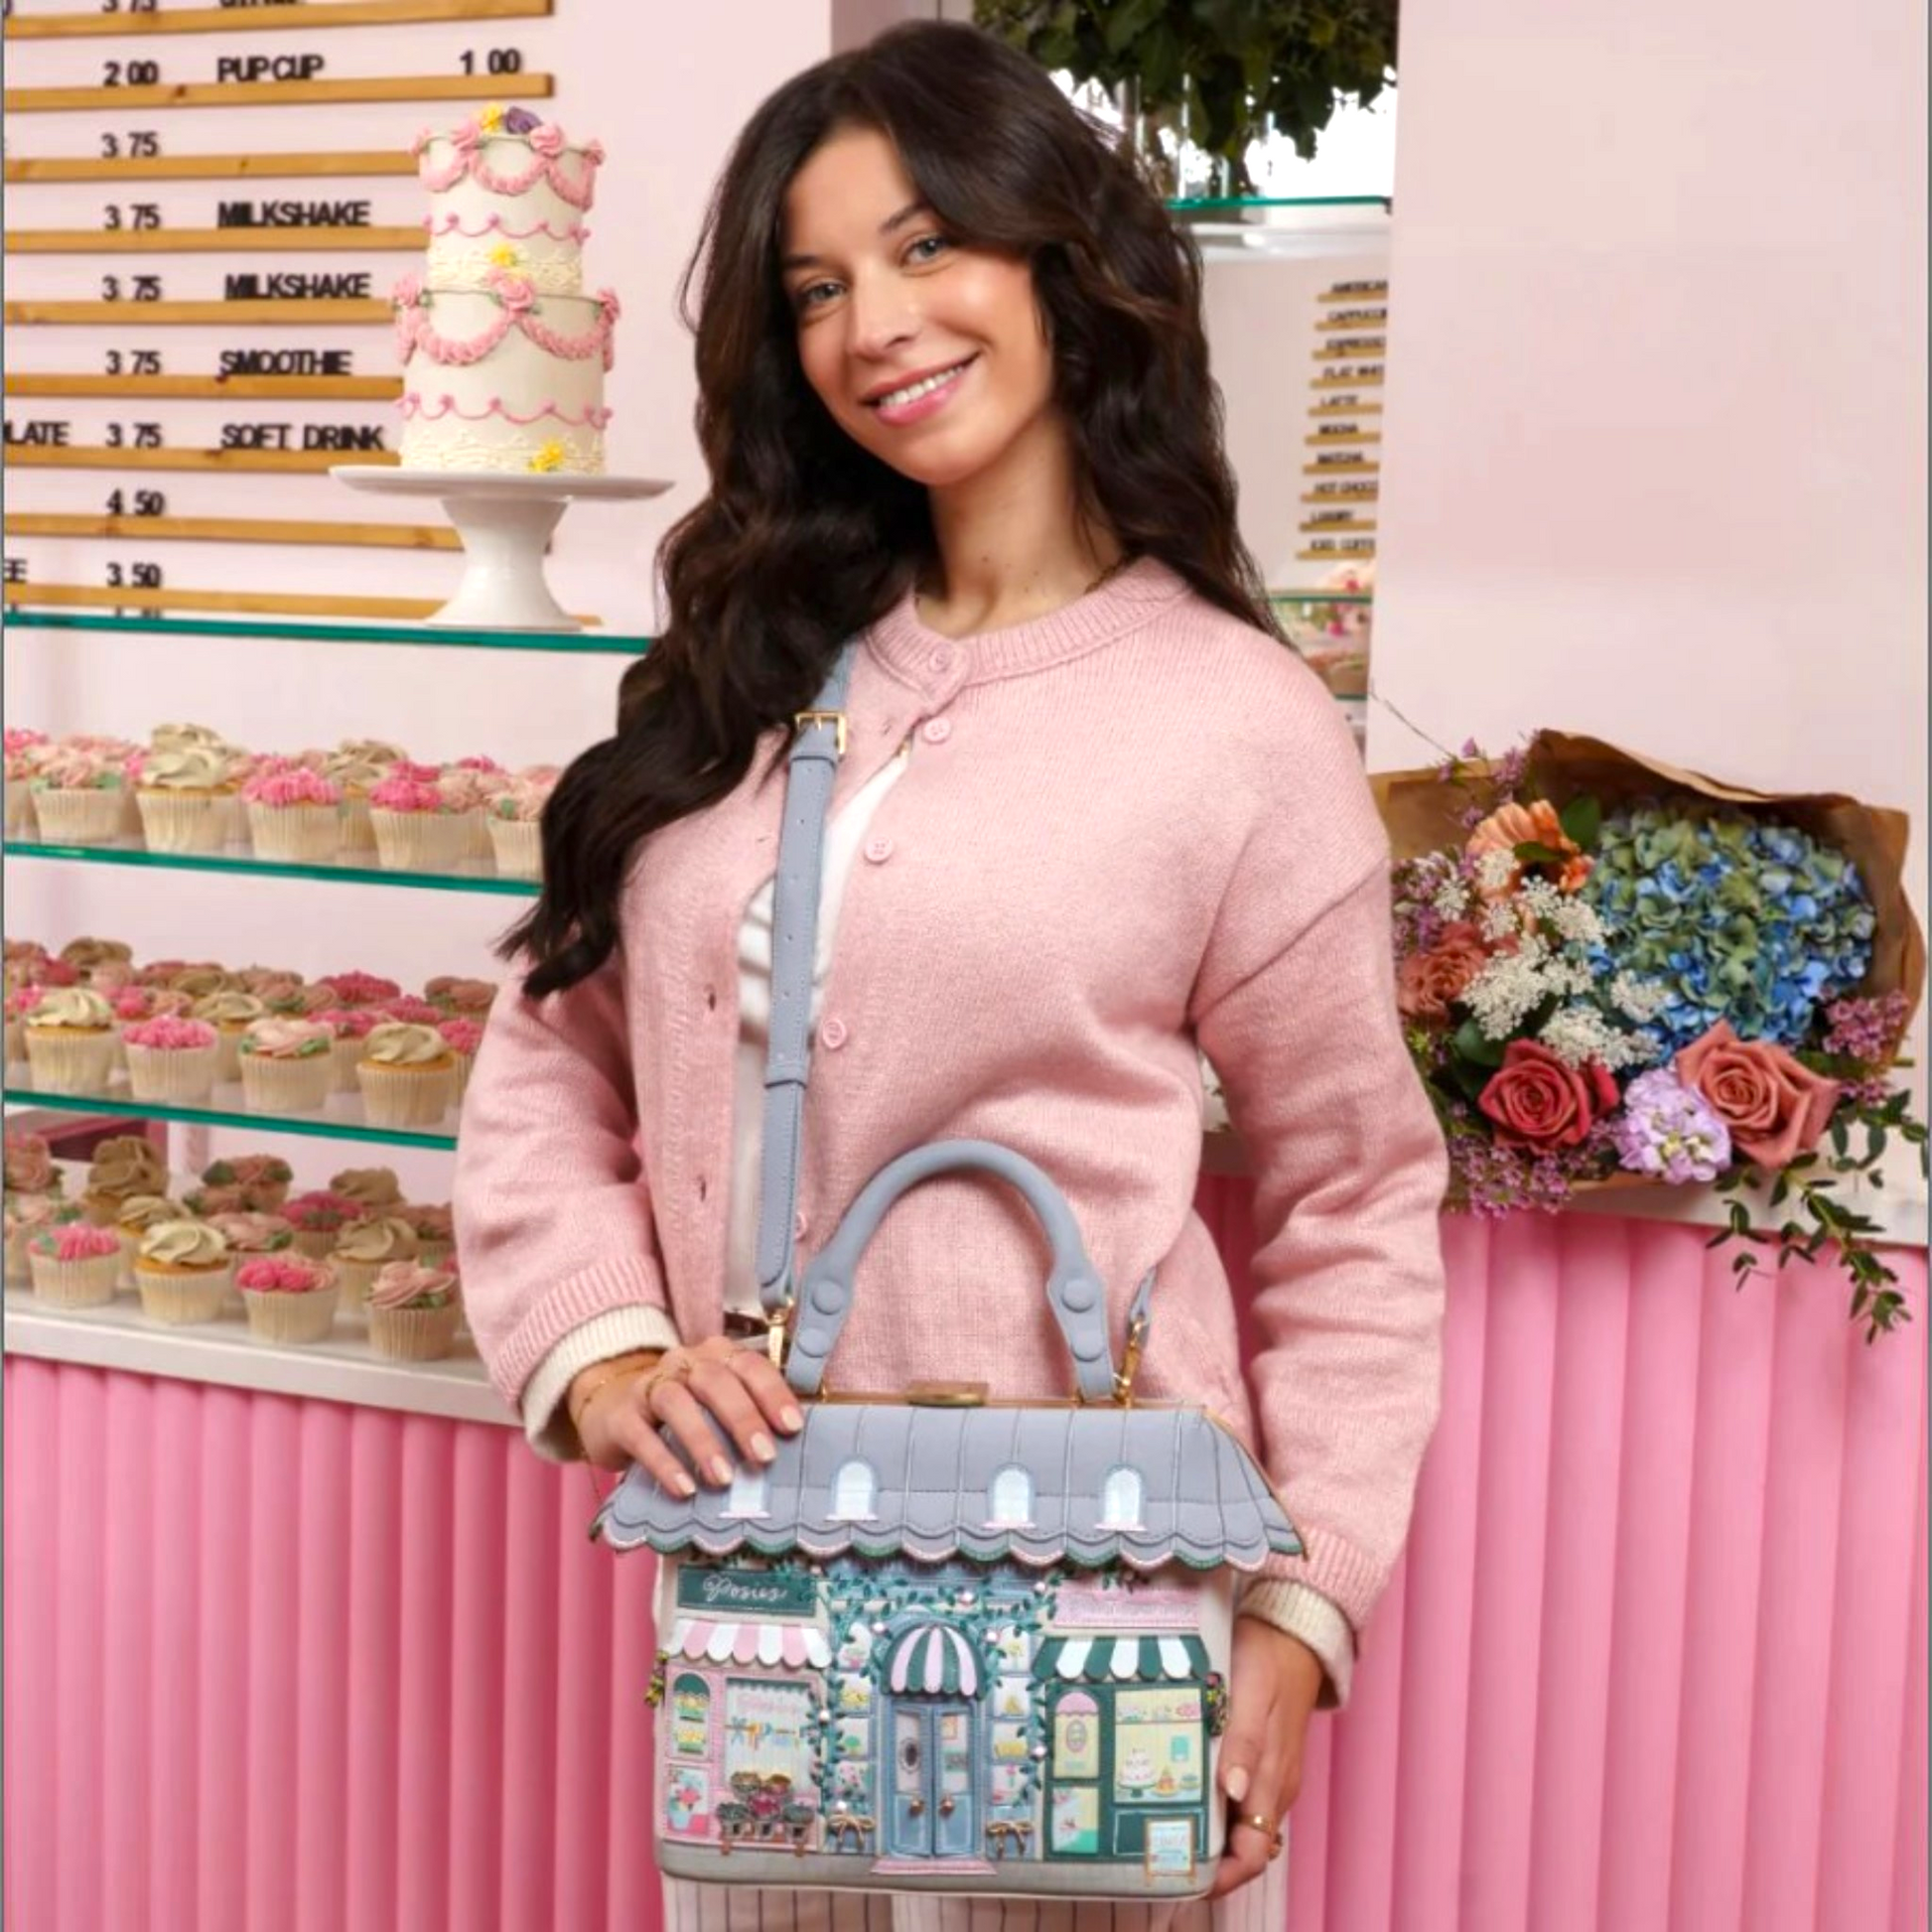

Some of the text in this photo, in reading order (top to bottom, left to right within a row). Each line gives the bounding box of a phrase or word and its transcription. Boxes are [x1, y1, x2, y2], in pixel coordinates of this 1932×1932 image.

[218, 202, 368, 227] MILKSHAKE
[225, 274, 369, 300] MILKSHAKE
[221, 350, 350, 374] SMOOTHIE
[1320, 395, 1358, 405] LATTE
[221, 425, 384, 451] SOFT DRINK
